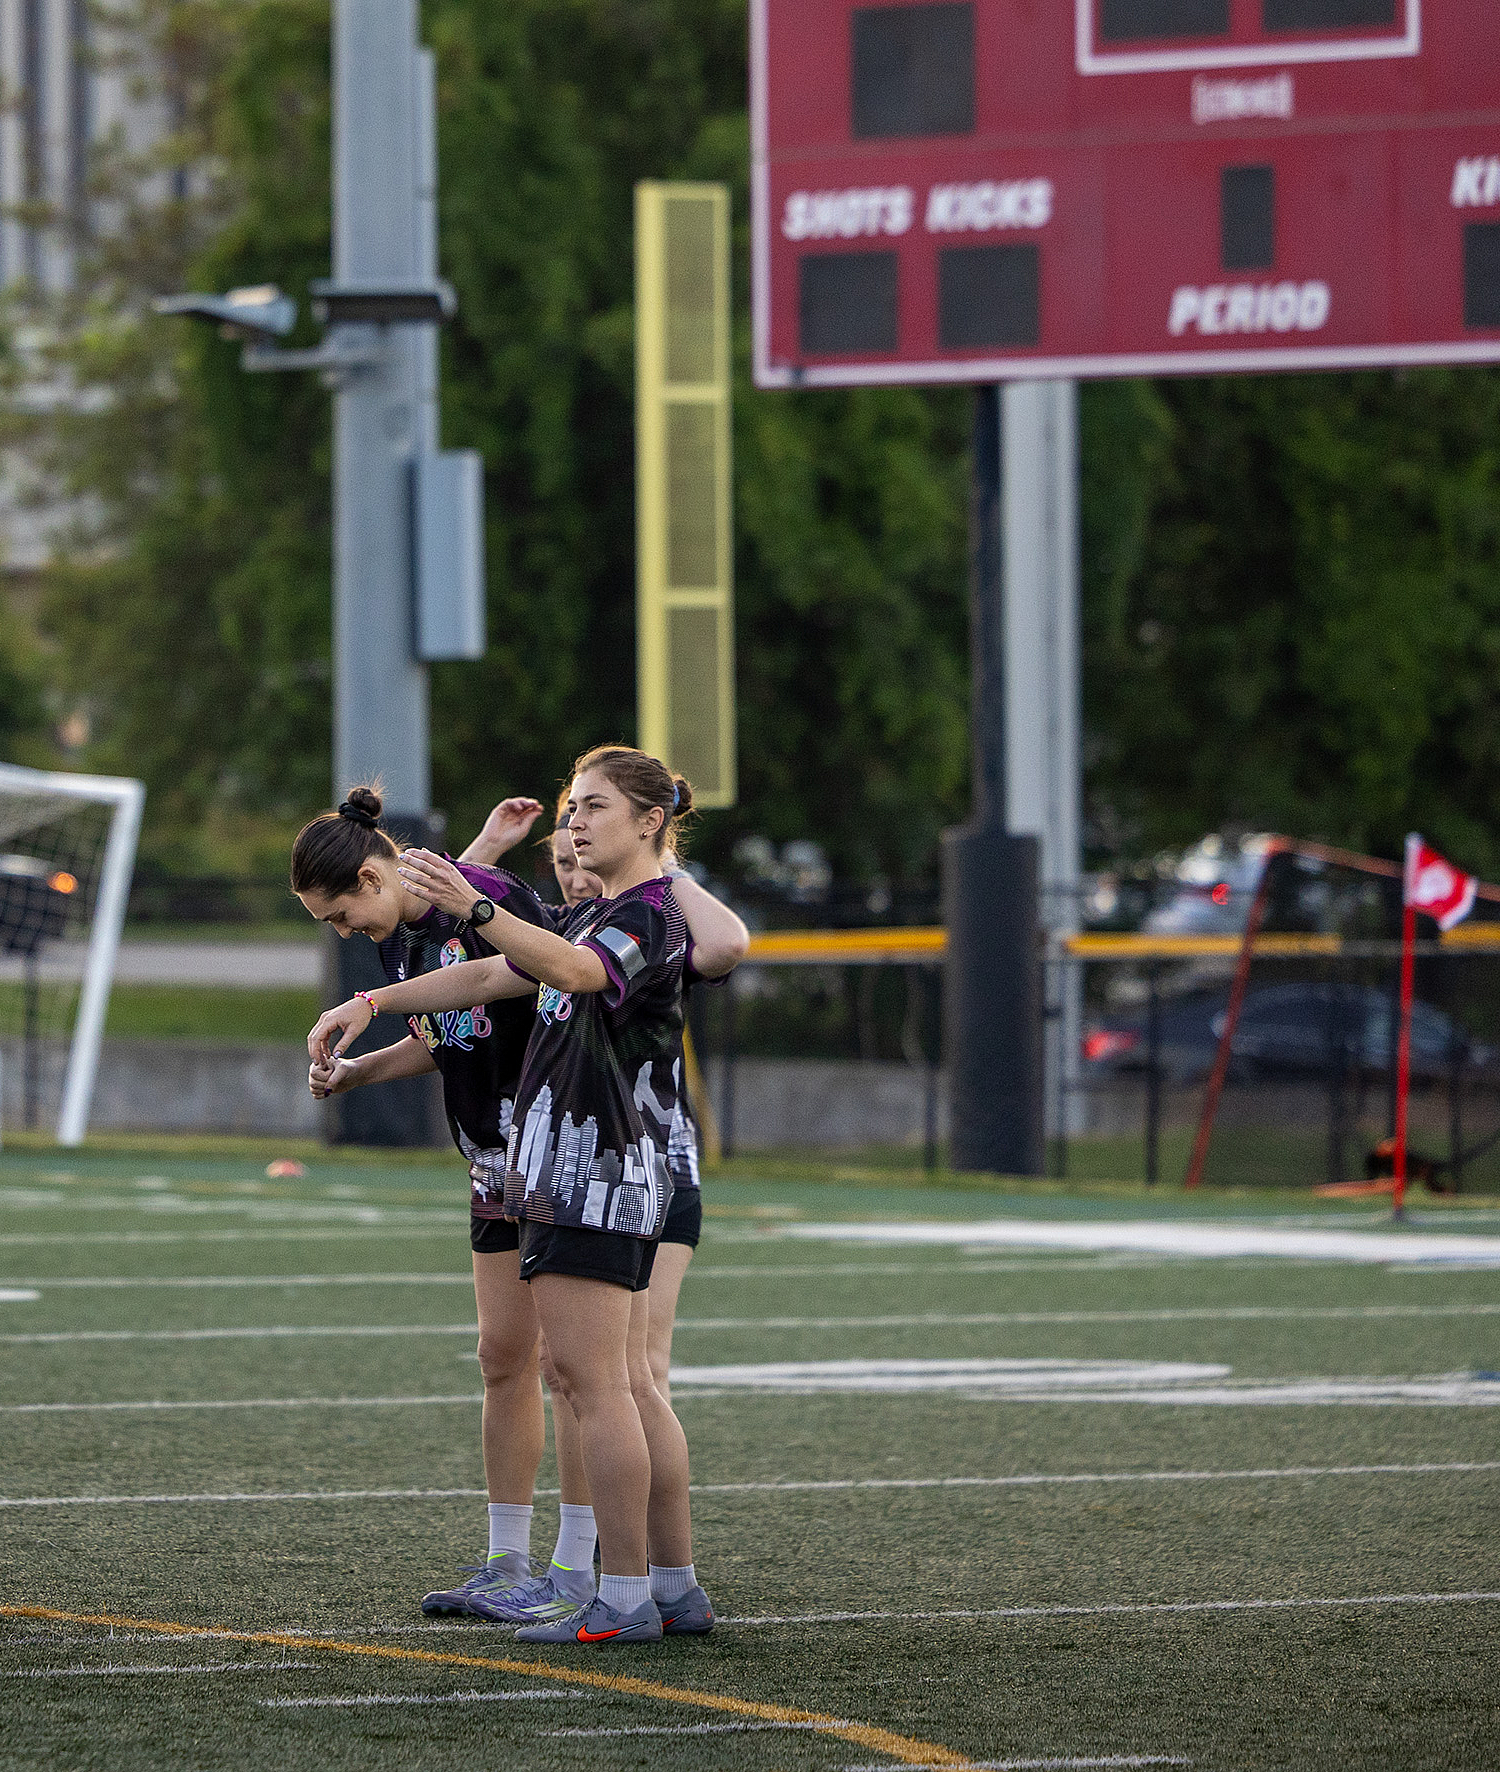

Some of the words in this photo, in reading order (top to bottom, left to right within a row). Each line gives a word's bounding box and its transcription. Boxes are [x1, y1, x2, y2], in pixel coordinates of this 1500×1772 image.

[783, 186, 913, 239] SHOTS
[925, 178, 1052, 232] KICKS
[1450, 155, 1500, 208] KI
[1168, 281, 1330, 336] PERIOD
